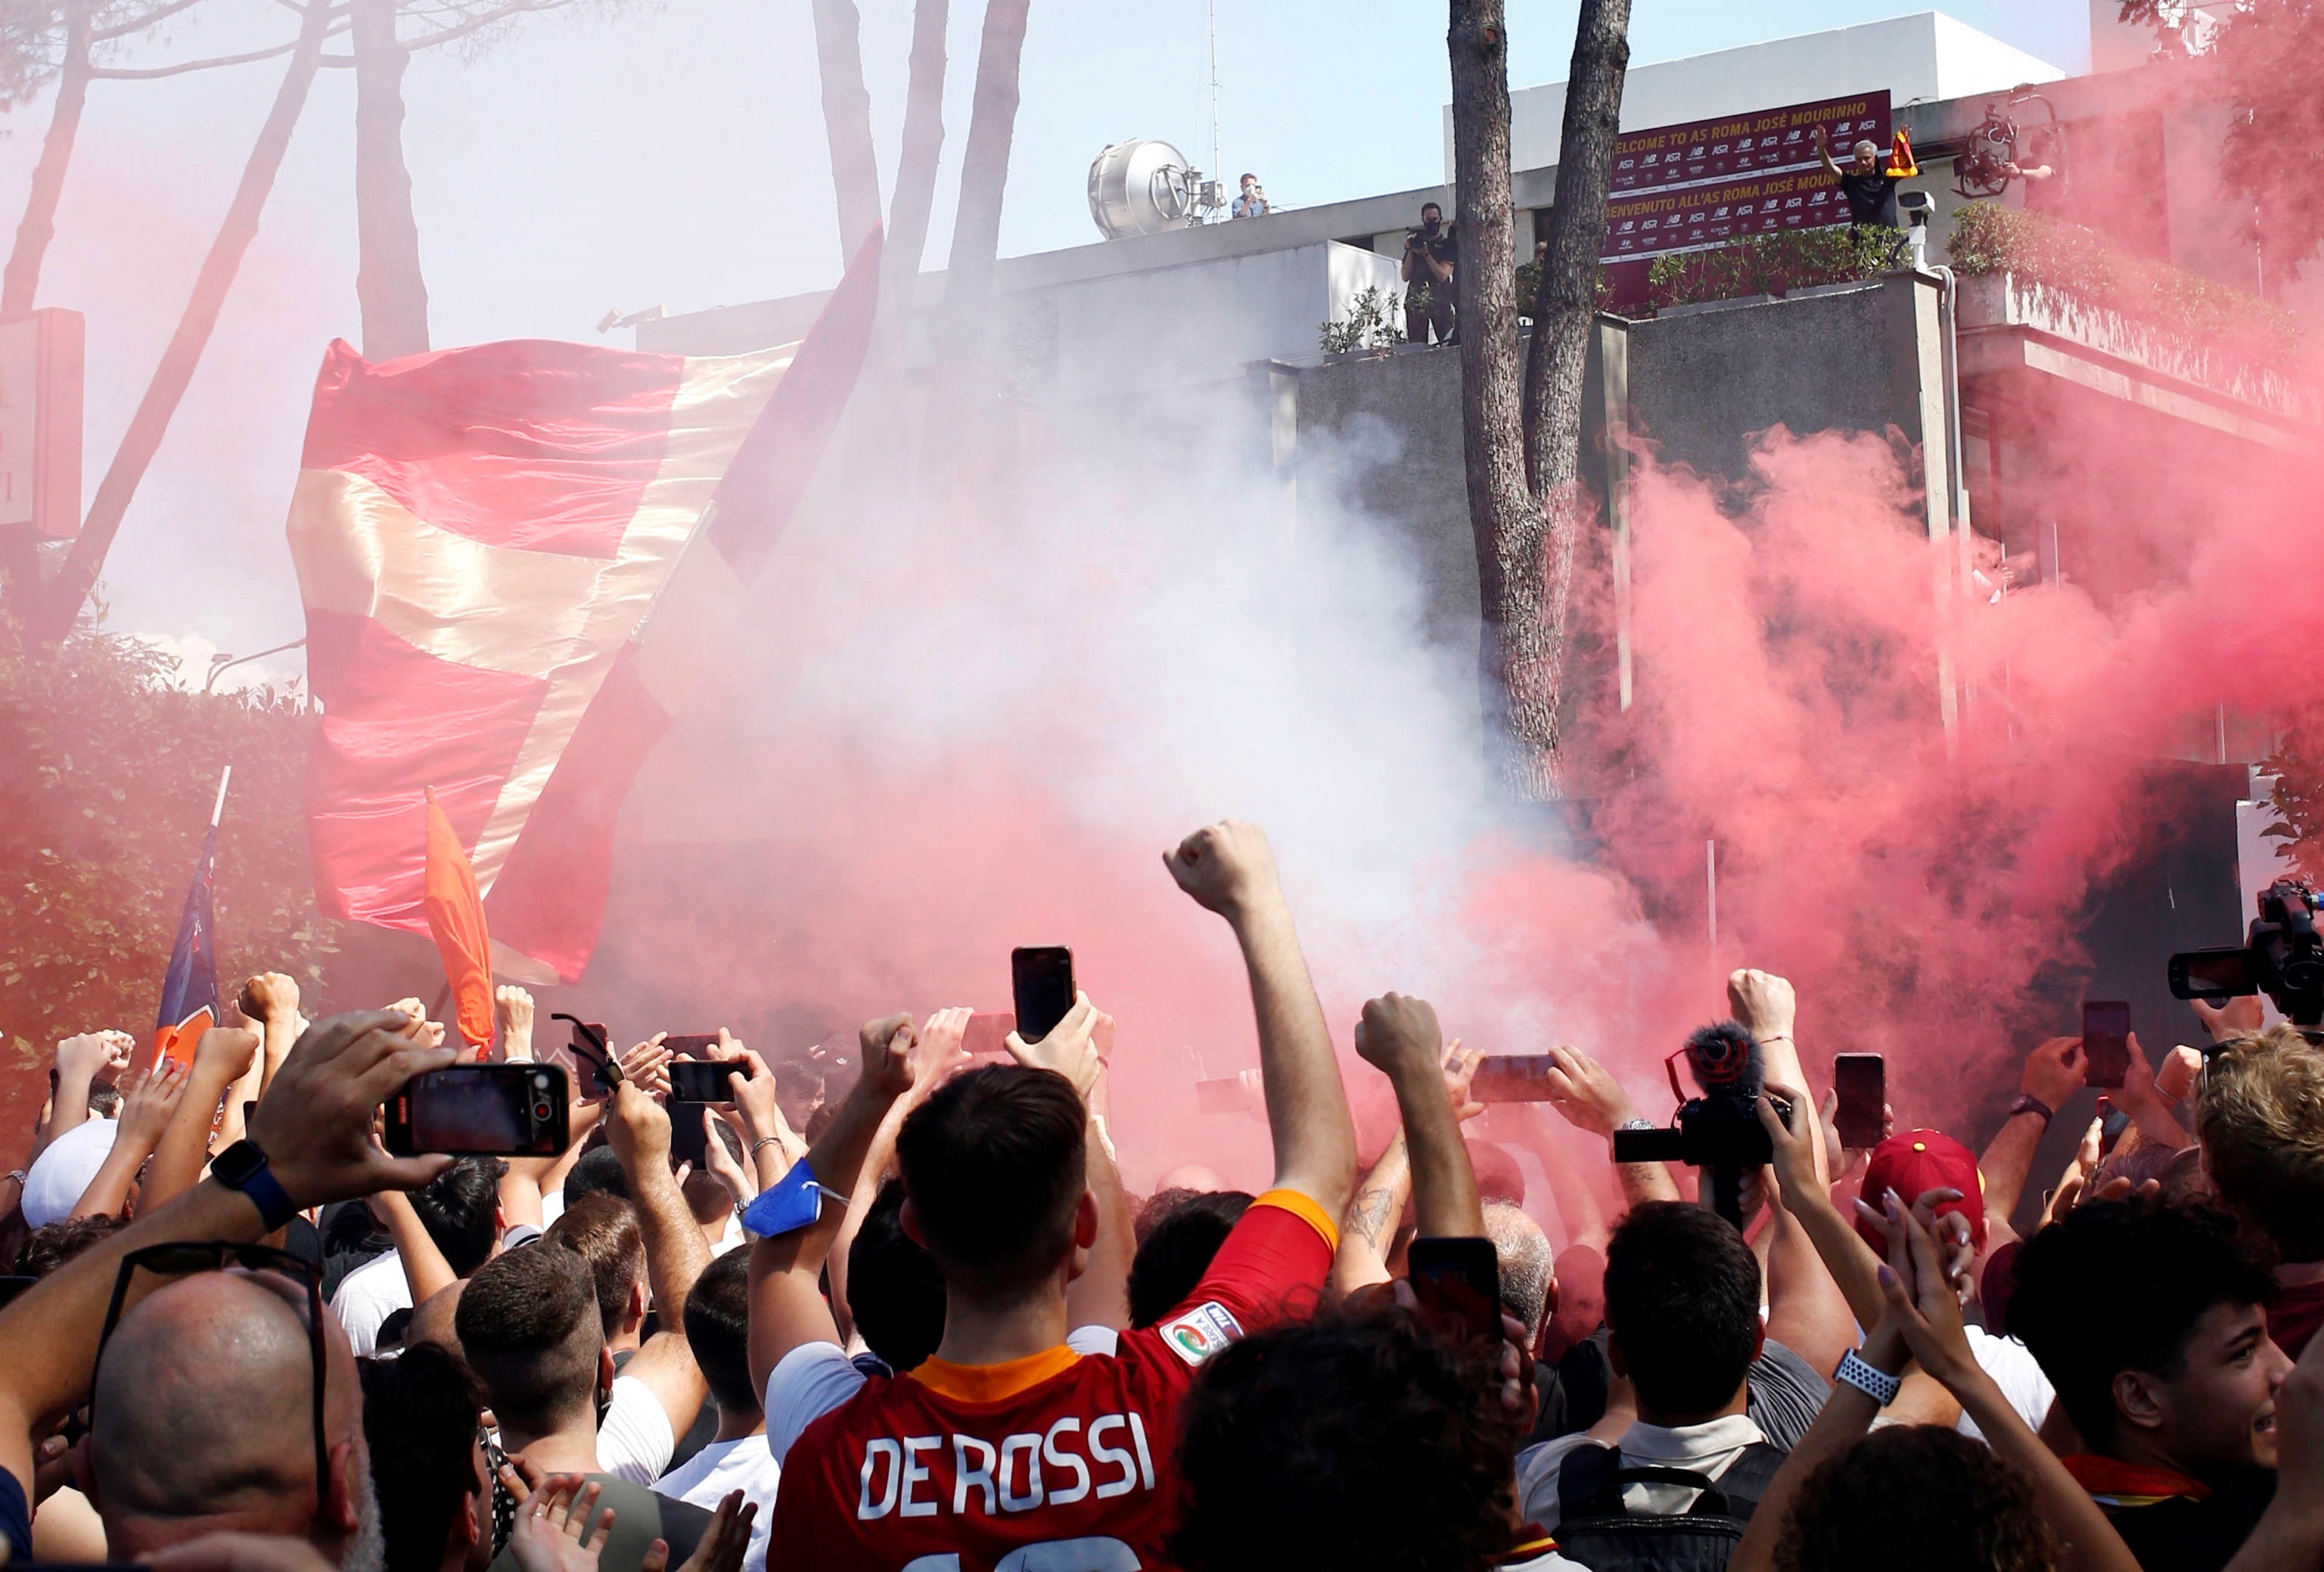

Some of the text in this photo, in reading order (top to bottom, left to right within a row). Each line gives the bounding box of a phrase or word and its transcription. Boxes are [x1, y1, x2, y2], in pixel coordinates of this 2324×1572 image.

[1614, 102, 1867, 154] ELCOME TO AS ROMA JOSÉ MOURINHO
[1618, 160, 1635, 170] ASR
[1664, 152, 1681, 163] ASR
[1712, 144, 1729, 155] ASR
[1761, 136, 1778, 148] ASR
[1859, 120, 1876, 131] ASR
[1641, 219, 1658, 231] ASR
[1689, 213, 1705, 223] ASR
[1736, 205, 1754, 216] ASR
[1785, 197, 1803, 209] ASR
[1835, 191, 1848, 201] AS
[1678, 191, 1720, 209] ALL'AS
[1723, 185, 1760, 203] ROMA
[1763, 176, 1794, 195] JOSÉ
[1201, 1324, 1223, 1349] SERIE
[1208, 1307, 1231, 1328] TIM
[858, 1412, 1154, 1521] DE ROSSI
